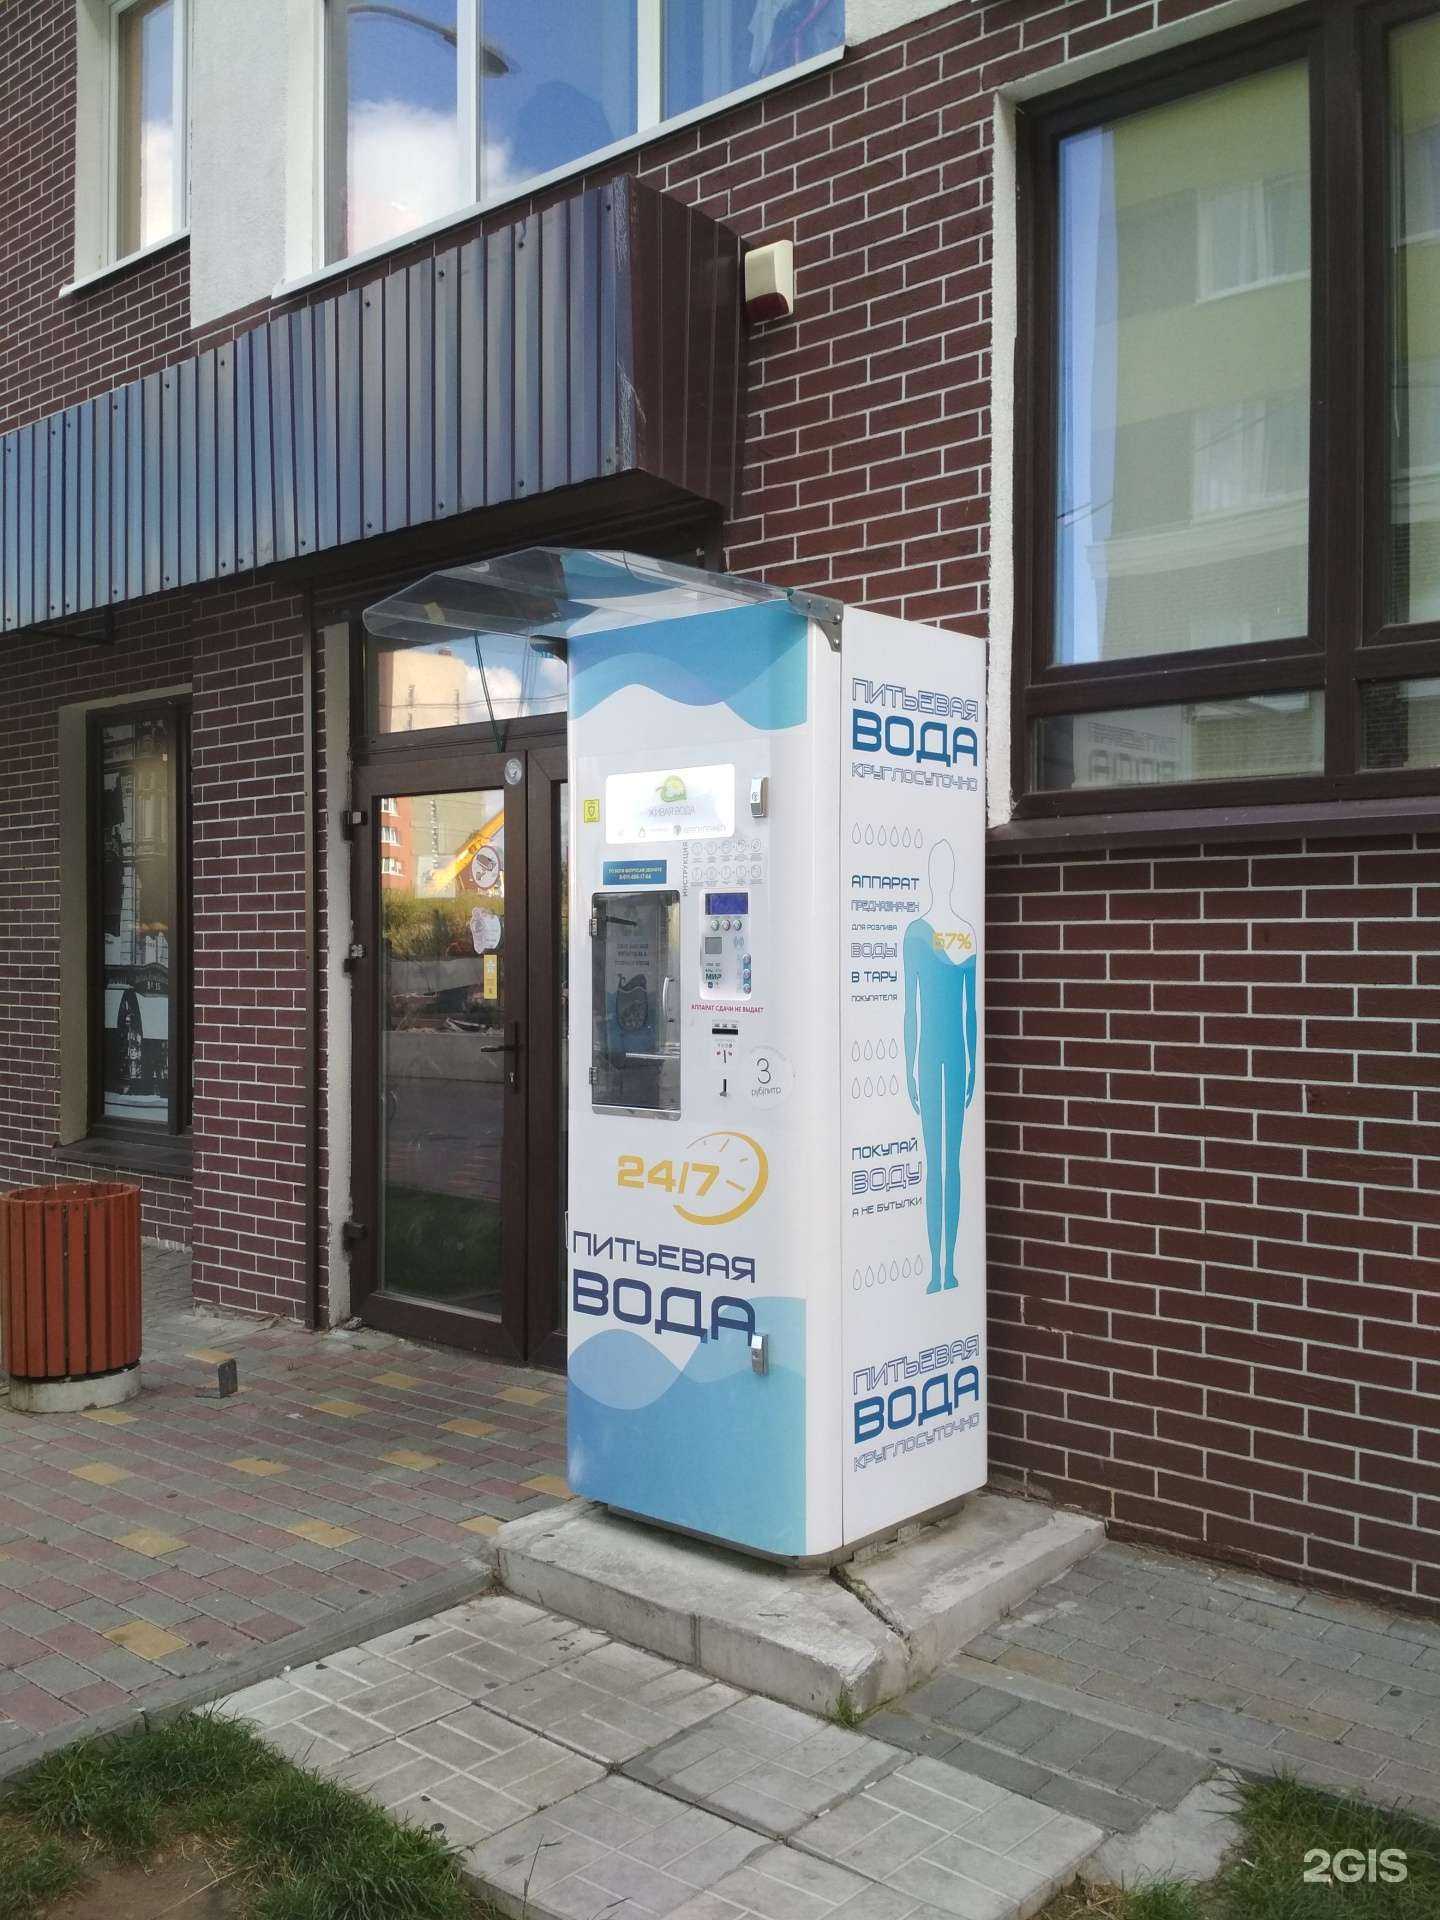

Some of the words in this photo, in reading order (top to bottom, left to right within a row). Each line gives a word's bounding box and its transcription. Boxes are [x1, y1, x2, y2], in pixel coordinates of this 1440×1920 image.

[852, 677, 979, 722] ПИТЬЕВАЯ
[852, 708, 978, 767] ВОДА
[851, 762, 978, 792] КРУГЛОСУТОЧНО
[851, 875, 920, 891] АППАРАТ
[851, 900, 920, 913] ПРЕДНАЗНАЧЕН
[851, 923, 866, 931] ДЛЯ
[850, 942, 898, 960] ВОДЫ
[705, 973, 722, 981] МИР
[851, 971, 860, 983] В
[864, 970, 898, 982] ТАРУ
[851, 993, 898, 1003] ПОКУПАТЕЛЯ
[756, 1057, 772, 1085] 3
[852, 1137, 919, 1161] ПОКУПАЙ
[617, 1154, 721, 1197] 24/7
[851, 1161, 923, 1196] ВОДУ
[852, 1207, 860, 1218] А
[861, 1204, 875, 1215] НЕ
[876, 1197, 923, 1214] БУТЫЛКИ
[572, 1230, 756, 1284] ПИТЬЕВАЯ
[572, 1268, 756, 1347] ВОДА
[853, 1334, 980, 1396] ПИТЬЕВАЯ
[854, 1365, 979, 1445] ВОДА
[853, 1412, 980, 1472] КРУГЛОСУТОЧНО
